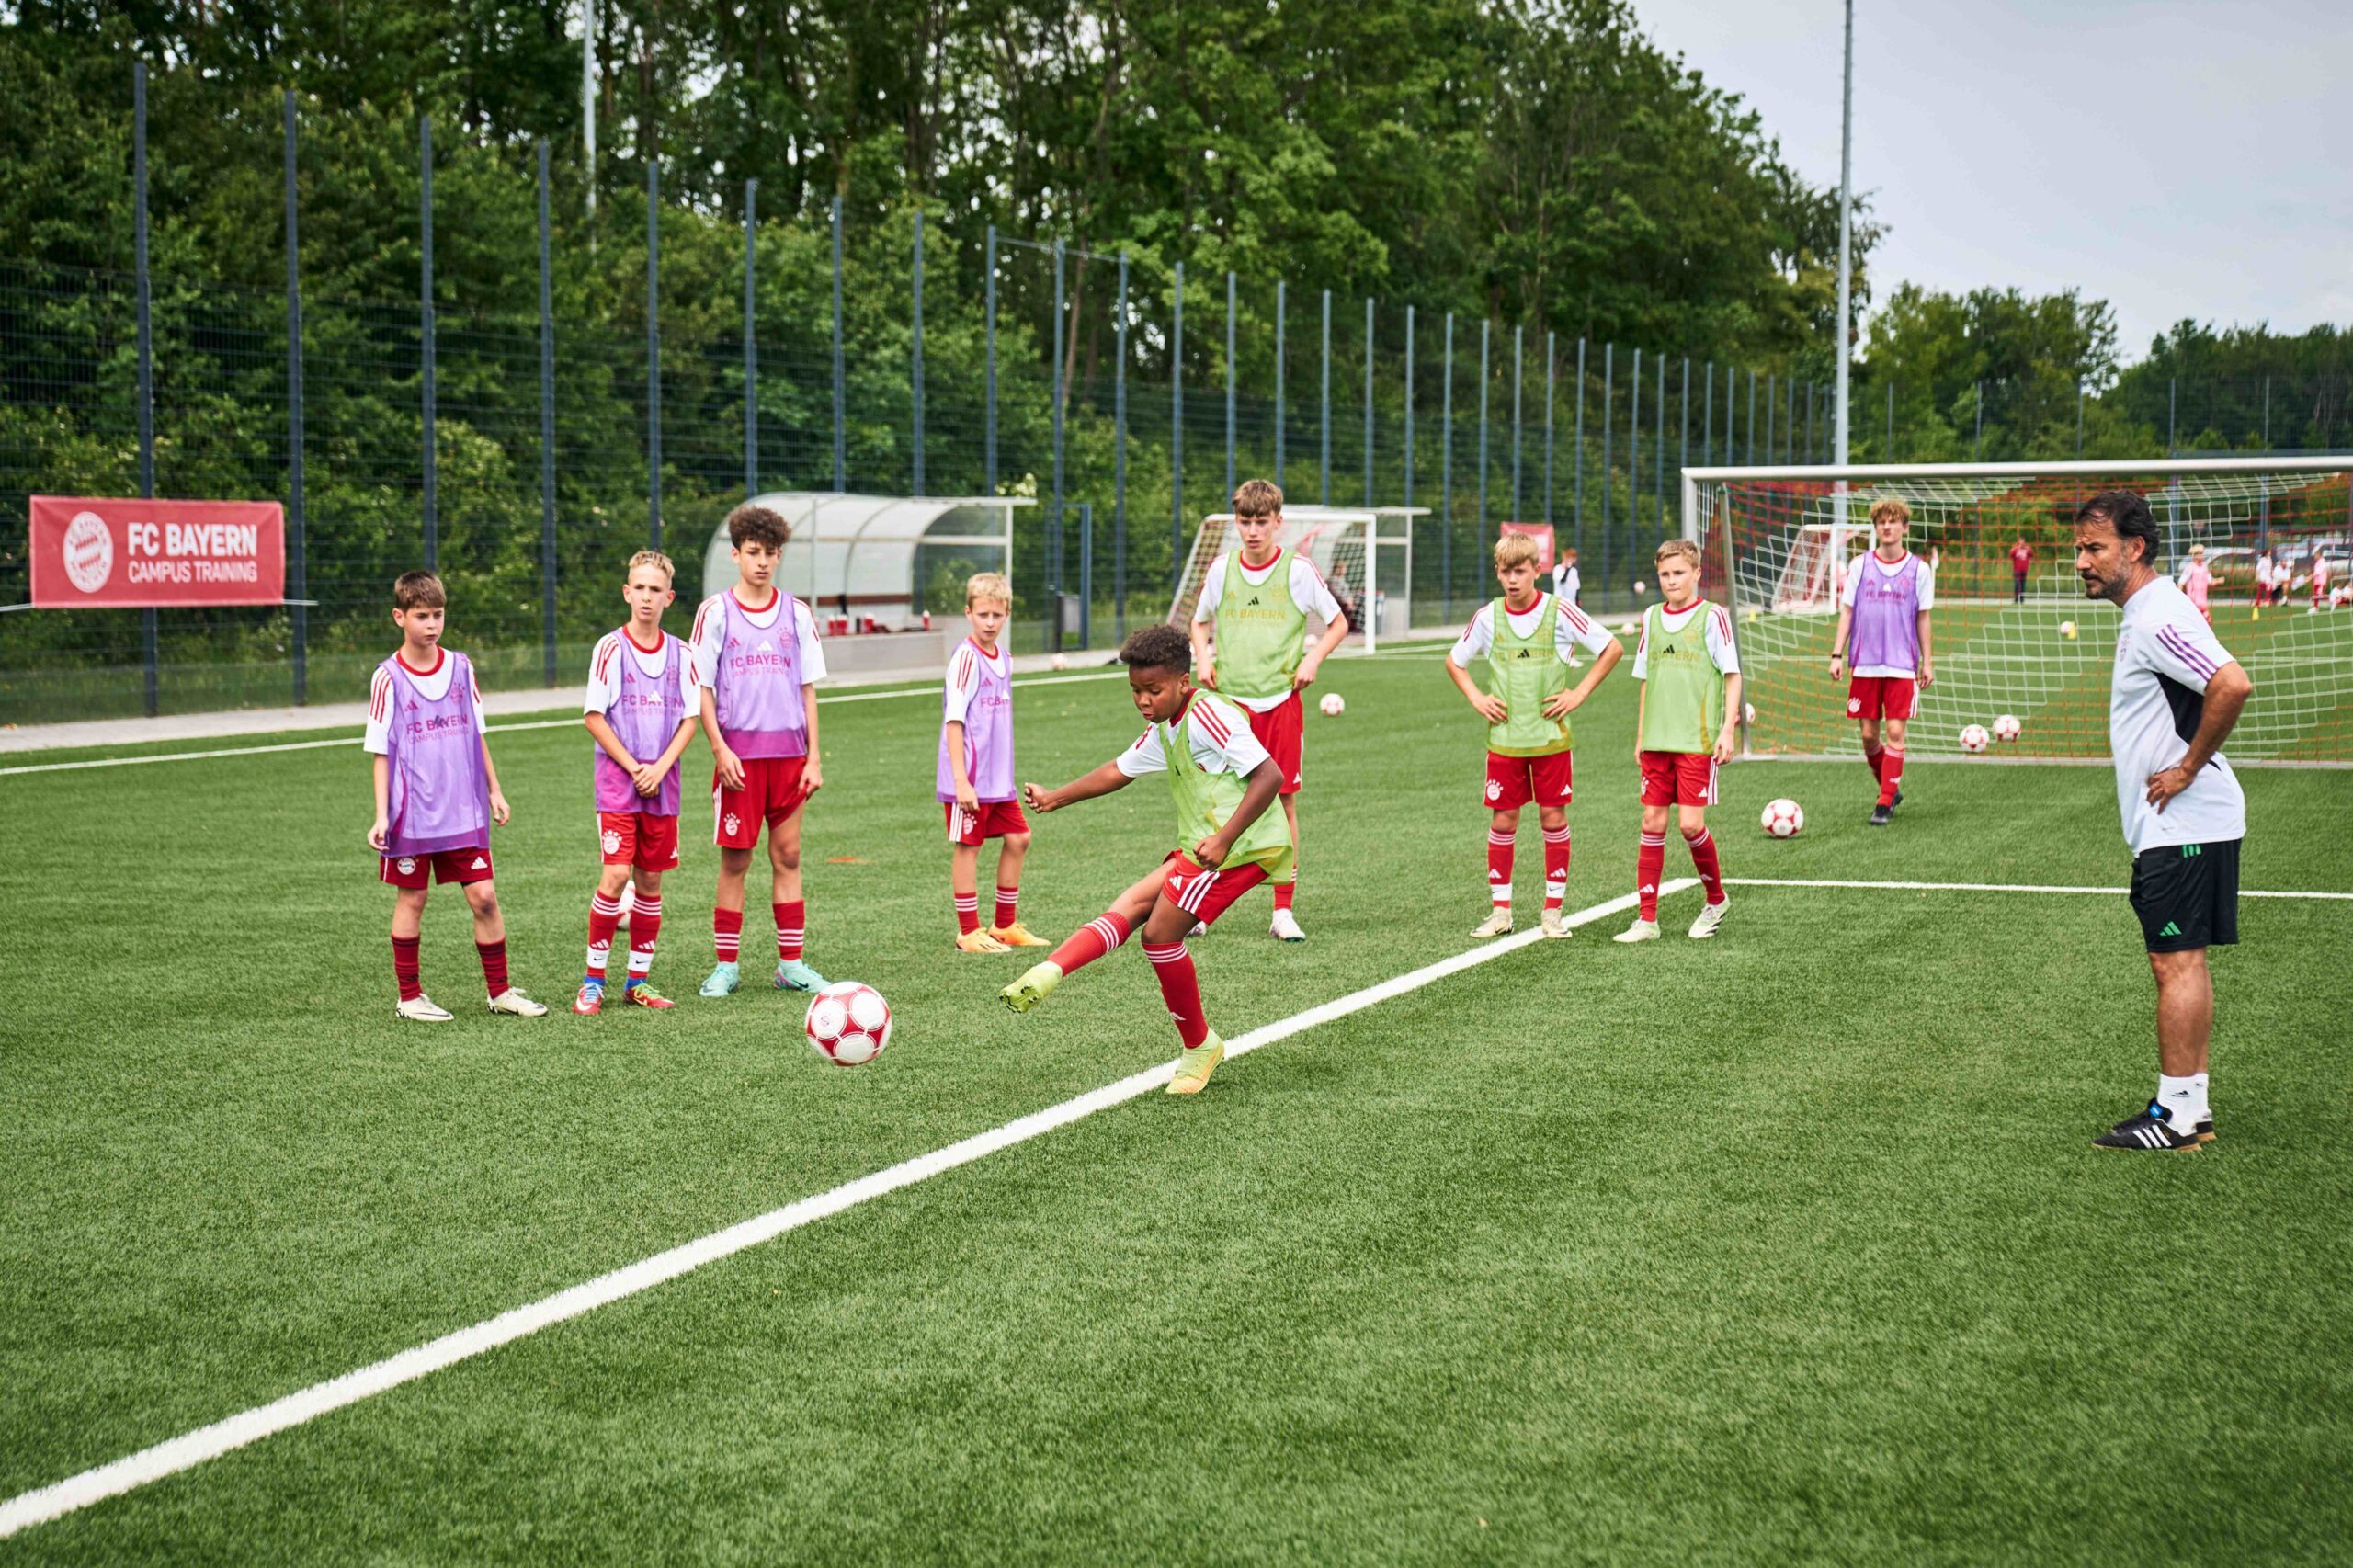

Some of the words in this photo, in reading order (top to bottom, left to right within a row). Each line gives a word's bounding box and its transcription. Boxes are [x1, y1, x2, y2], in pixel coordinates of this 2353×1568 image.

[128, 522, 160, 556] FC
[165, 523, 257, 556] BAYERN
[129, 560, 192, 583] CAMPUS
[193, 560, 257, 583] TRAINING
[621, 694, 637, 707] FC
[981, 697, 995, 708] FC
[406, 721, 423, 735] FC
